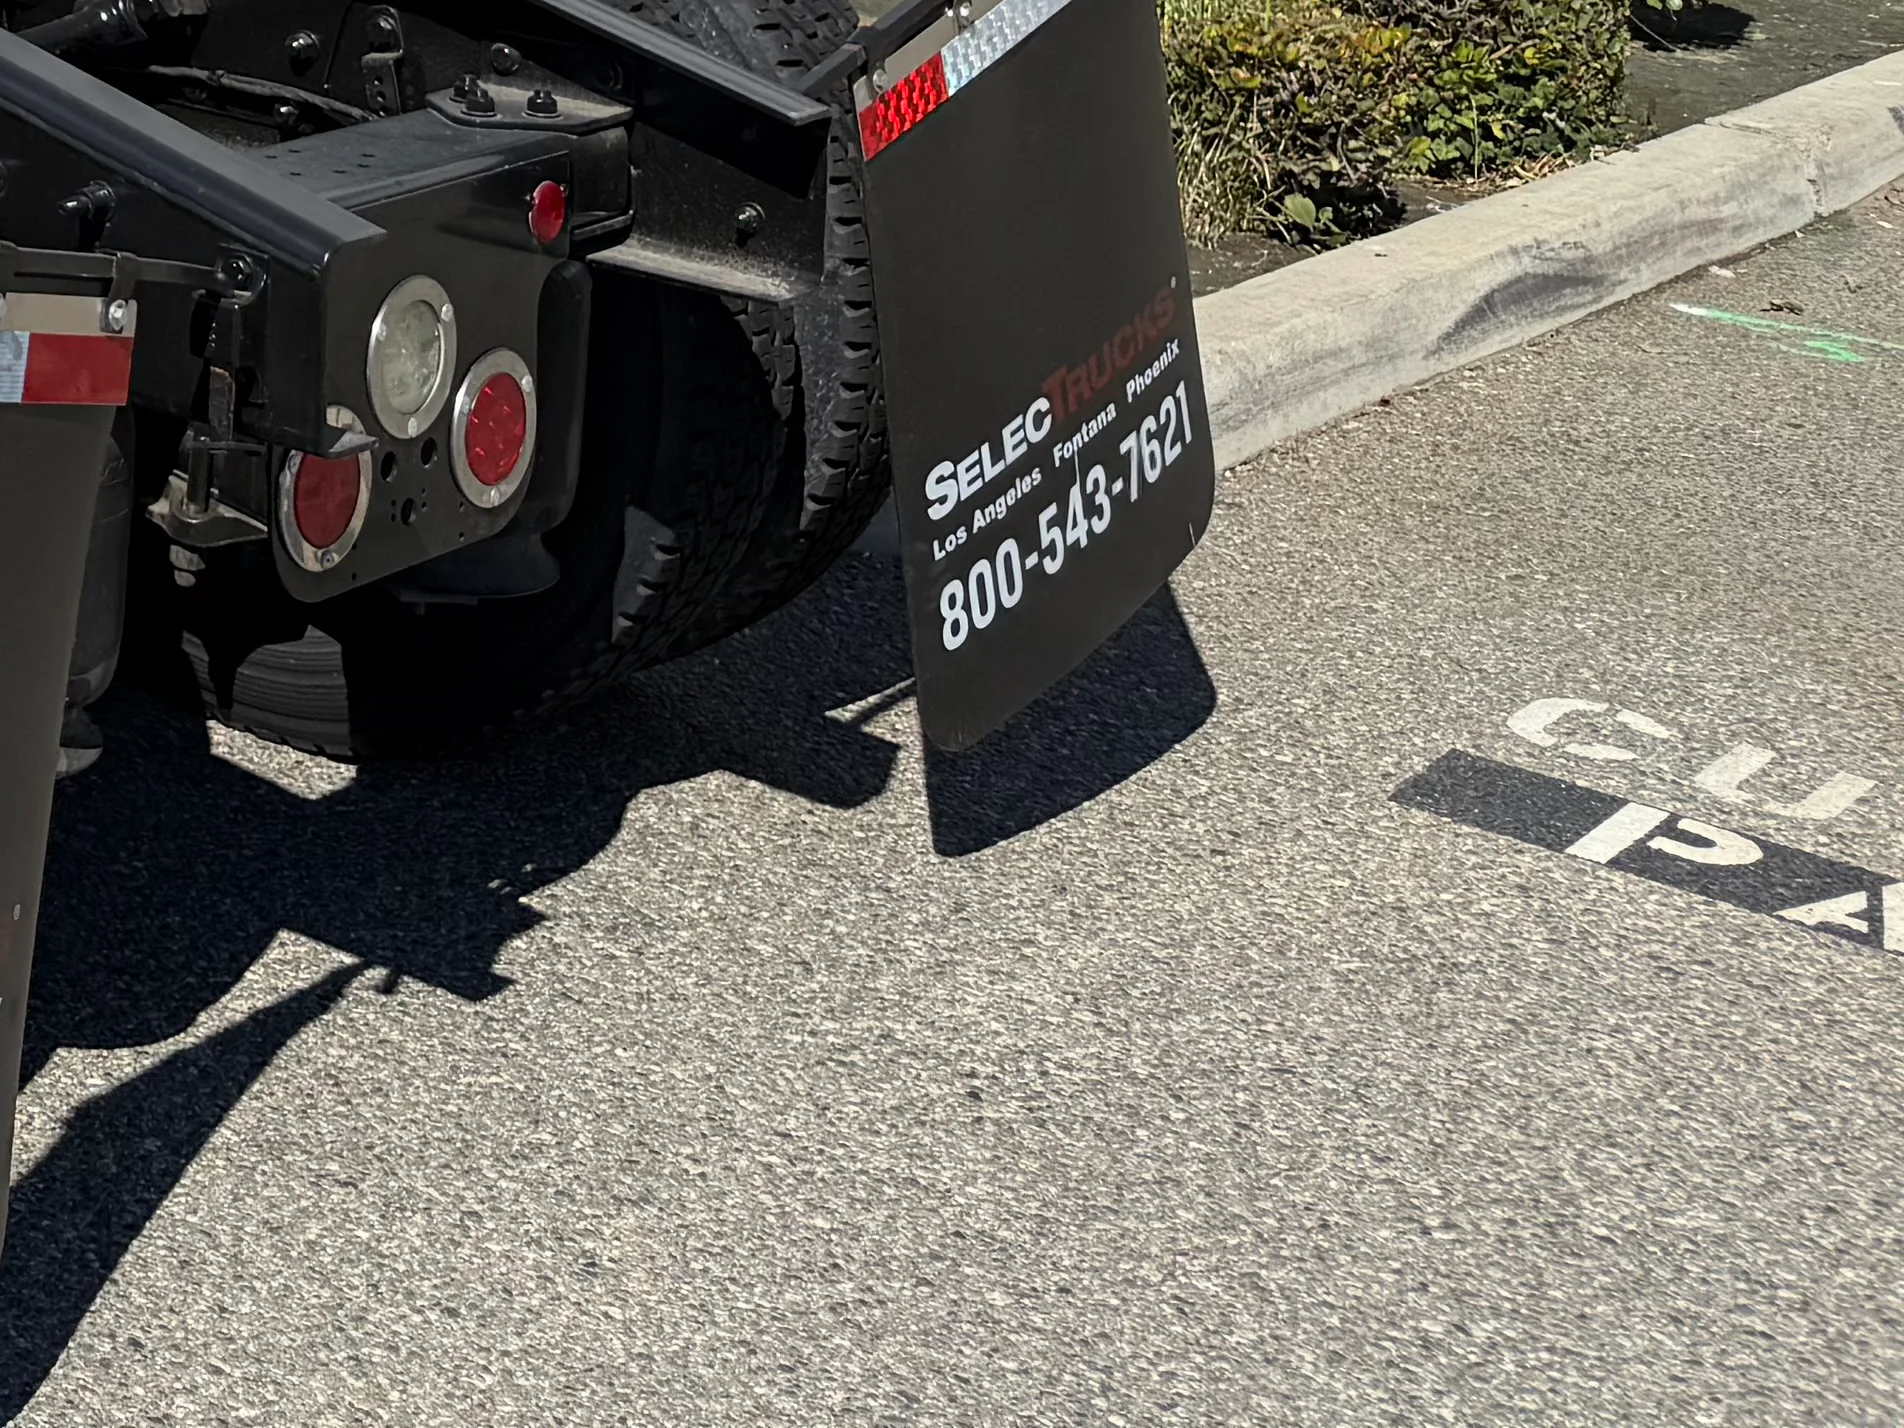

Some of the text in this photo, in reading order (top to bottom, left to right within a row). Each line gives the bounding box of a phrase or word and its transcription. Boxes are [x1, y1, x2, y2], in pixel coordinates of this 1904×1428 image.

[932, 337, 1180, 562] Los Angeles Fontana Phoenix
[939, 380, 1192, 652] 800-543-7621
